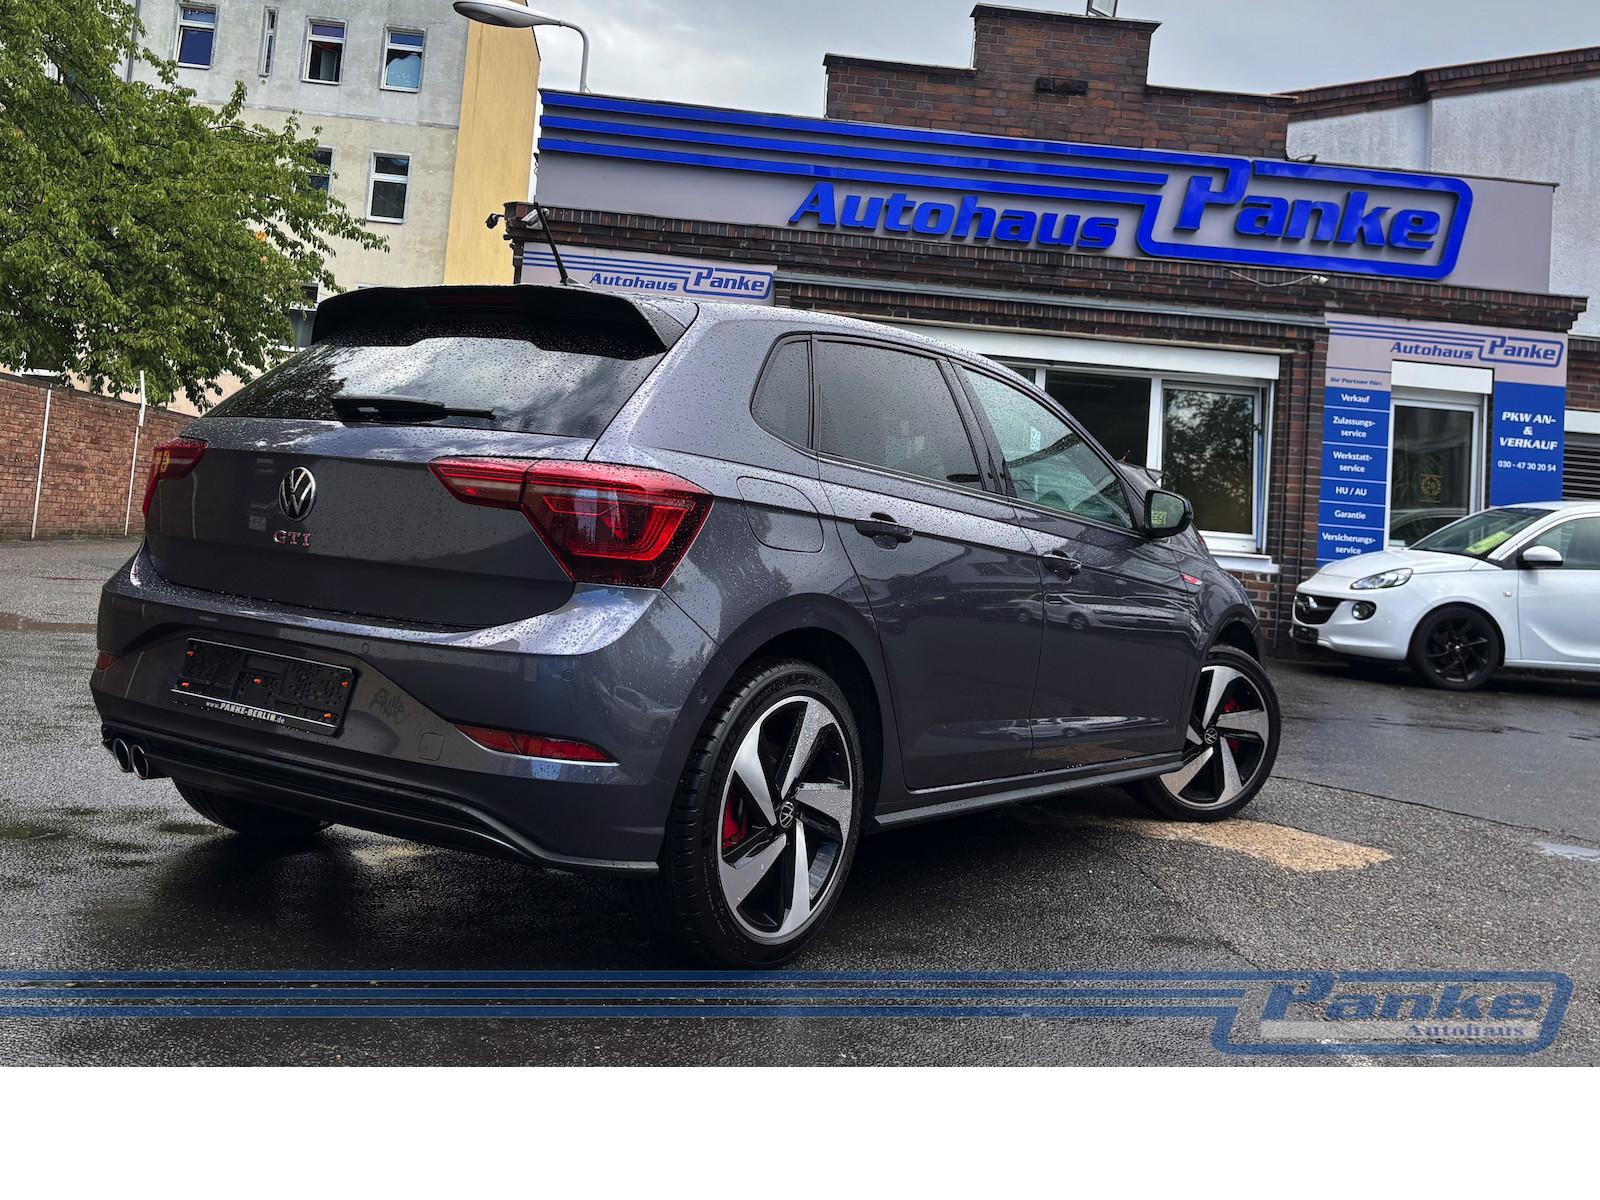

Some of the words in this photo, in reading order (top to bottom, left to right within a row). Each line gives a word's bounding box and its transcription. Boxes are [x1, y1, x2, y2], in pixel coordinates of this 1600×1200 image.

[789, 182, 1118, 249] Autohaus
[1172, 163, 1443, 251] Panke
[589, 272, 678, 291] Autohaus
[694, 268, 765, 292] Panke
[1390, 341, 1473, 360] Autohaus
[1488, 337, 1556, 361] Panke
[1340, 393, 1370, 403] Verkauf
[1332, 416, 1376, 428] Zulassungs-
[1501, 411, 1533, 423] PKW
[1533, 414, 1556, 424] AN-
[1340, 429, 1367, 438] service
[1523, 426, 1533, 436] &
[1499, 437, 1558, 451] VERKAUF
[1332, 451, 1373, 463] Werkstatt-
[1339, 463, 1366, 473] service
[1497, 460, 1511, 469] 030
[1516, 461, 1526, 469] 47
[1526, 462, 1536, 471] 30
[1537, 463, 1546, 471] 20
[1547, 464, 1557, 472] 54
[1335, 486, 1349, 496] HU
[1354, 487, 1368, 497] AU
[1334, 509, 1366, 520] Garantie
[272, 529, 312, 547] GTI
[1321, 532, 1376, 546] Versicherungs-
[1335, 545, 1362, 555] service
[205, 701, 285, 725] www.PANKE-BERLIN.de
